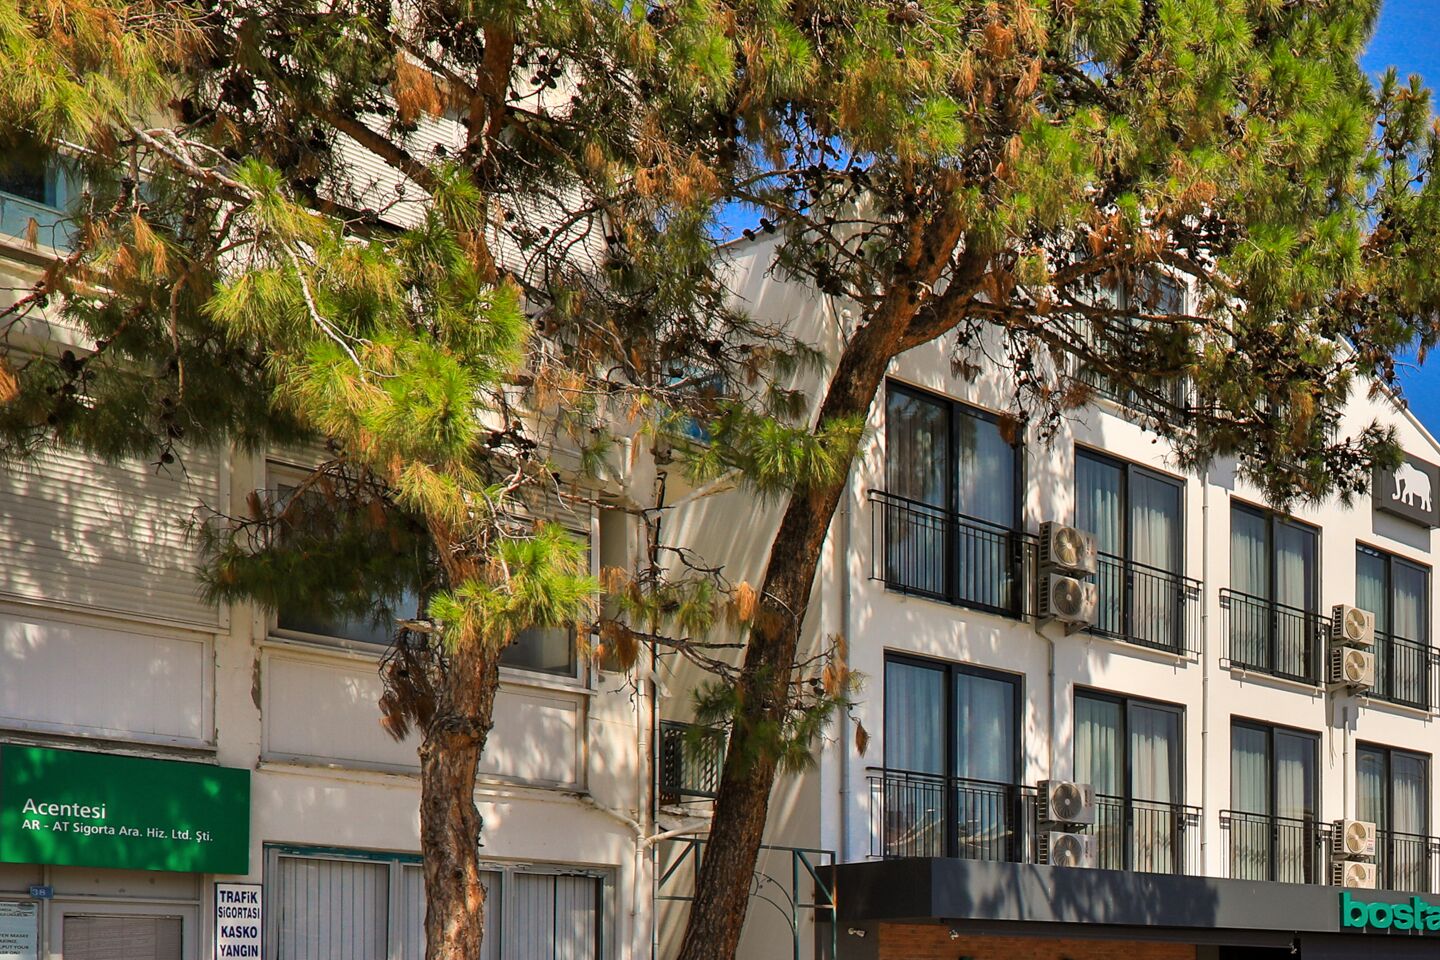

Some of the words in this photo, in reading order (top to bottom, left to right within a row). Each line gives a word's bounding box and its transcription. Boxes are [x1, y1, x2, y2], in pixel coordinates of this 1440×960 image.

[22, 798, 106, 820] Acentesi
[22, 819, 41, 831] AR
[52, 821, 70, 832] AT
[73, 822, 115, 836] Sigorta
[118, 826, 143, 837] Ara.
[147, 828, 168, 839] Hiz.
[172, 829, 192, 841] Ltd.
[196, 831, 213, 843] Şti.
[32, 888, 46, 896] 38
[221, 925, 258, 939] KASKO
[220, 944, 258, 957] YANGIN
